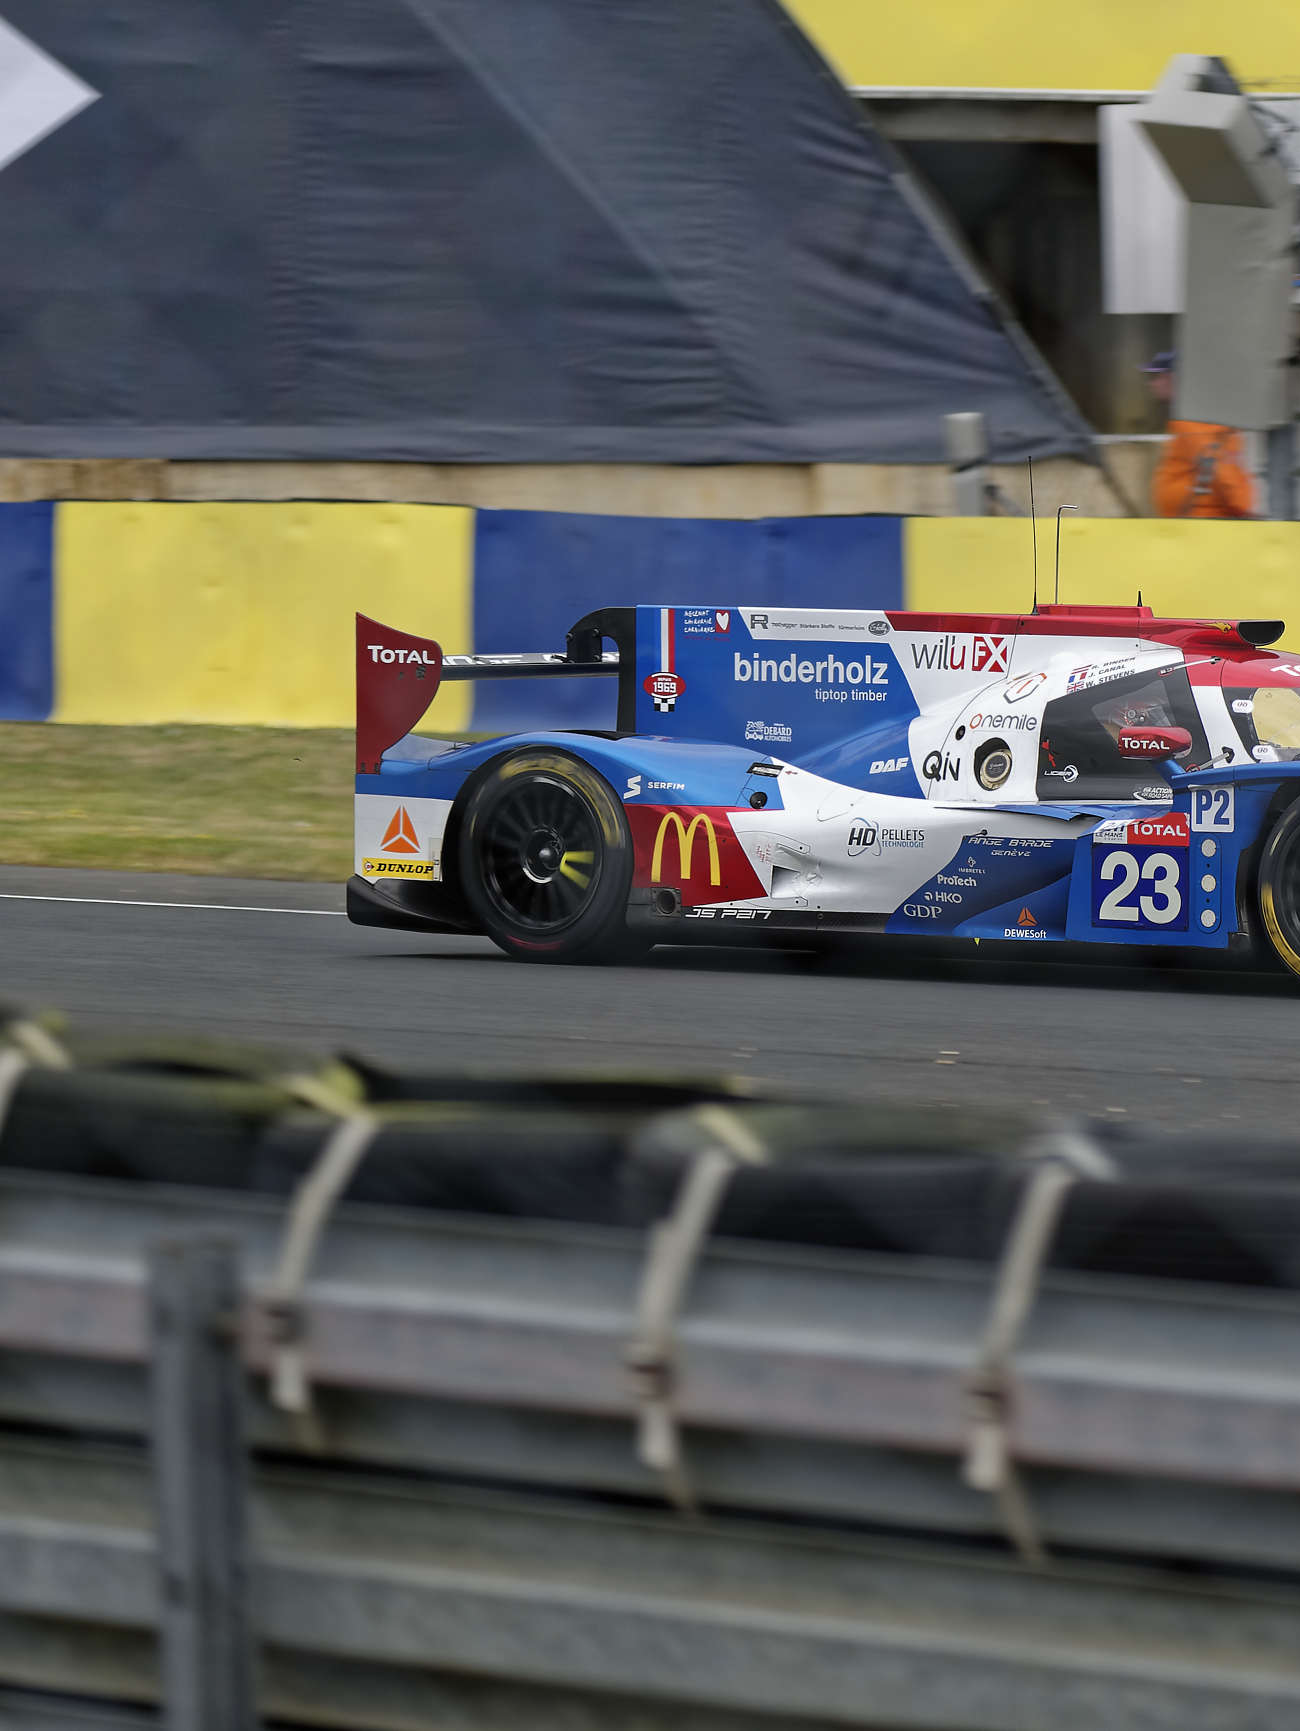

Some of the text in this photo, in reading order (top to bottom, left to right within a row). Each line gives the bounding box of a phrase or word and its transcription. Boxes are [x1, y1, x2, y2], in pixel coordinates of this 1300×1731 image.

[367, 645, 436, 665] TOTAL
[734, 652, 889, 685] binderholz
[1098, 664, 1126, 675] CANAL
[1098, 669, 1136, 684] STEVENS
[653, 682, 677, 693] 1969
[815, 688, 888, 702] tiptop timber
[763, 726, 792, 736] DEBARD
[1122, 737, 1170, 750] TOTAL
[869, 757, 909, 774] DAF
[647, 781, 686, 790] SERFIM
[1195, 789, 1230, 826] P2
[848, 827, 925, 846] HD PELLETS
[375, 863, 434, 874] DUNLOP
[937, 874, 977, 887] ProTech
[1099, 850, 1182, 924] 23
[935, 891, 962, 904] HKO
[685, 909, 716, 918] JS
[903, 904, 942, 919] GDP
[1004, 928, 1047, 939] DEWESoft
